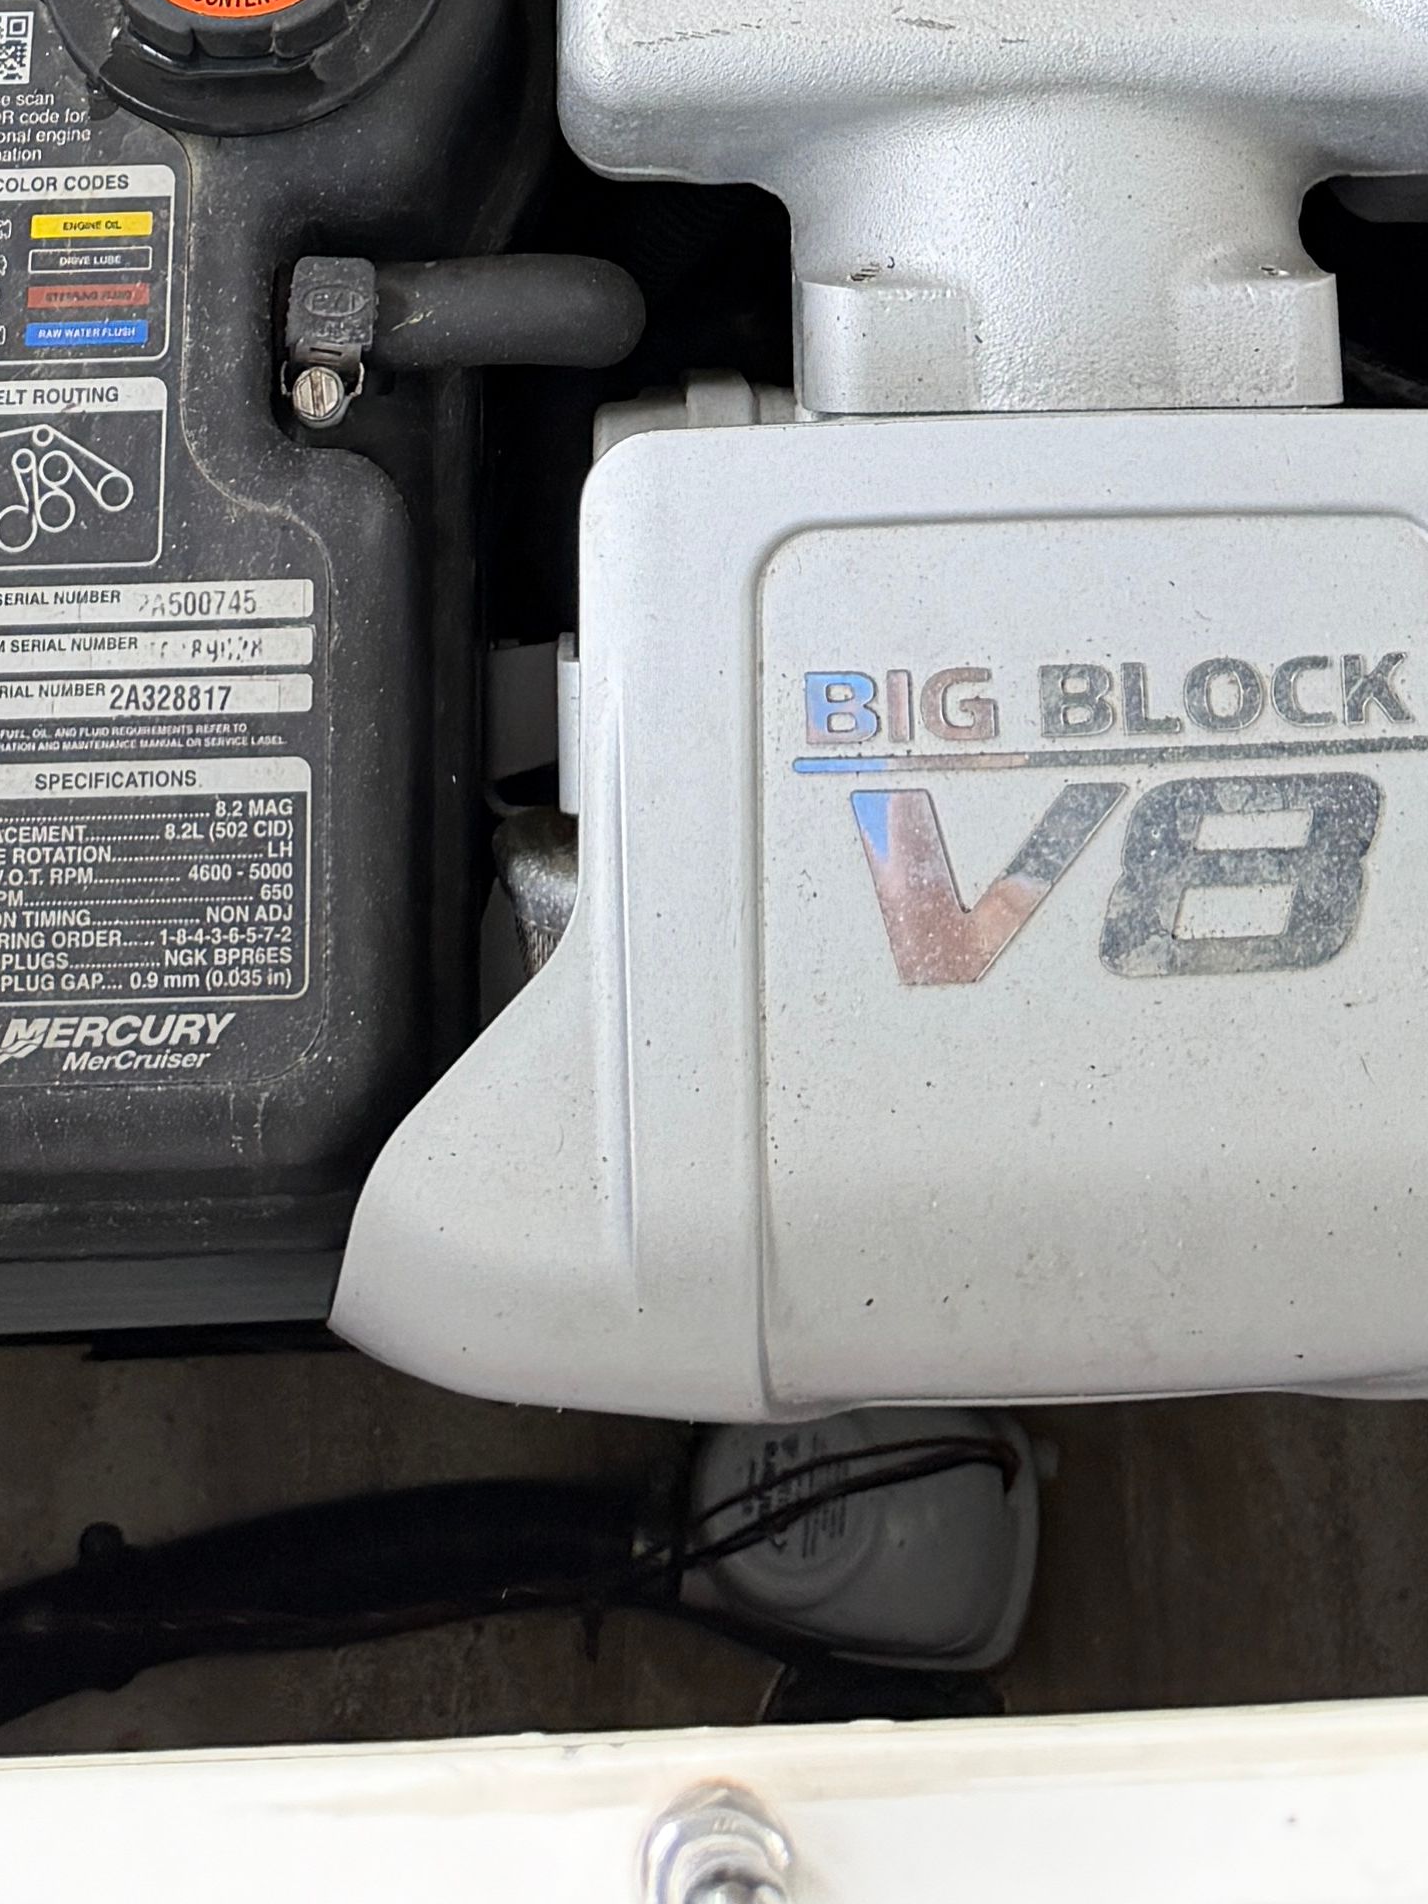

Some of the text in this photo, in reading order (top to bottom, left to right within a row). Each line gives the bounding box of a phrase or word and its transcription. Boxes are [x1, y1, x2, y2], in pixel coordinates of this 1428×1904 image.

[15, 93, 55, 107] scan
[19, 109, 60, 124] code
[64, 108, 86, 123] for
[35, 128, 92, 146] engine
[64, 174, 130, 191] CODES
[105, 220, 122, 230] OIL
[93, 255, 122, 265] LUBE
[38, 326, 136, 339] RAW WATER FLUSH
[32, 386, 119, 406] ROUTING
[53, 589, 121, 605] NUMBER
[10, 637, 66, 654] SERIAL
[70, 636, 139, 652] NUMBER
[38, 682, 106, 699] NUMBER
[109, 684, 232, 712] 2A328817
[803, 651, 1416, 745] BIG BLOCK
[54, 727, 77, 738] AND
[79, 726, 110, 737] FLUID
[111, 724, 194, 737] REQUIREMENTS
[195, 724, 231, 734] REFER
[233, 723, 247, 733] TO
[38, 741, 61, 751] AND
[62, 739, 138, 751] MAINTENANCE
[139, 738, 184, 749] MANUAL
[186, 738, 202, 748] OR
[204, 736, 248, 747] SERVICE
[34, 769, 197, 790] SPECIFICATIONS
[215, 800, 242, 817] 8.2
[248, 799, 293, 817] MAG
[164, 824, 205, 840] 8.2L
[209, 822, 248, 841] (502
[252, 820, 294, 839] CID)
[267, 842, 293, 858] LH
[188, 865, 233, 881] 4600
[249, 863, 294, 880] 5000
[849, 772, 1383, 987] V8
[260, 884, 293, 901] 650
[206, 906, 252, 923] NON
[255, 905, 293, 922] ADJ
[159, 927, 292, 945] 1-8-4-3-6-5-7-2
[164, 949, 208, 966] NGK
[214, 947, 293, 965] BPR6ES
[1, 974, 55, 992] PLUG
[130, 972, 158, 989] 0.9
[163, 973, 200, 988] mm
[205, 969, 262, 990] (0.035
[267, 968, 292, 988] in)
[62, 1051, 211, 1073] MerCruiser
